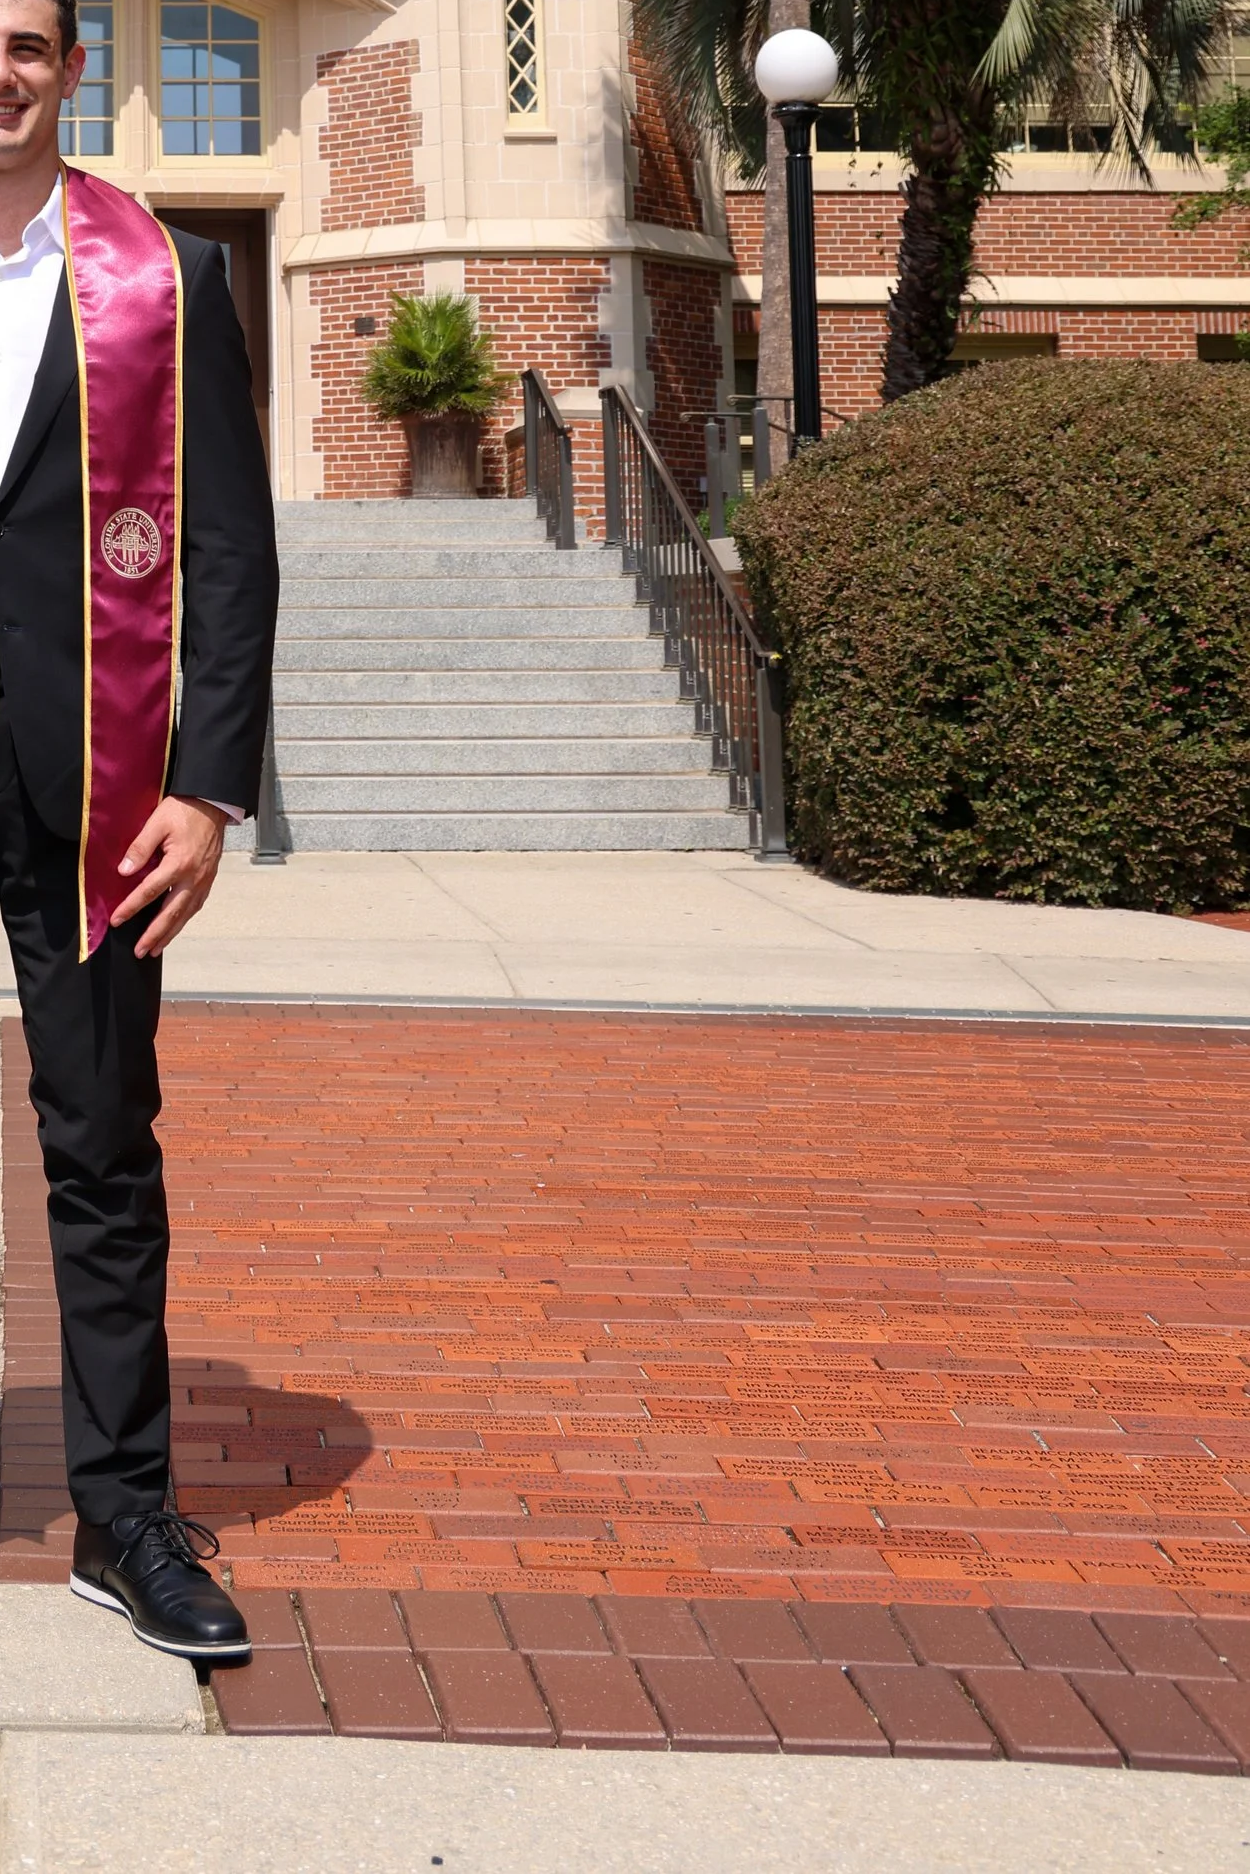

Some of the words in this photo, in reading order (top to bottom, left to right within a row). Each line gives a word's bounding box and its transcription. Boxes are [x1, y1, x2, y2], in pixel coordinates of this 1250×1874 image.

[105, 523, 116, 559] FLORIDA
[115, 512, 137, 523] STATE
[138, 515, 158, 563] UNIVERSITY
[123, 566, 139, 574] 1851
[765, 1383, 831, 1391] Memory
[813, 1479, 895, 1488] Matthew
[1070, 1478, 1174, 1486] Engineering
[979, 1486, 1051, 1495] Andrew
[823, 1492, 876, 1500] Class
[999, 1499, 1051, 1507] Class
[1057, 1501, 1074, 1509] of
[1080, 1503, 1129, 1511] 2023
[295, 1512, 319, 1520] Jay
[323, 1512, 415, 1520] Willoughby
[267, 1519, 333, 1527] Founder
[354, 1520, 418, 1528] Director
[269, 1526, 352, 1534] Classroom
[357, 1527, 420, 1536] Support
[815, 1526, 872, 1534] Taylor
[591, 1544, 669, 1552] Eldridge
[914, 1542, 972, 1550] Noles!
[897, 1552, 971, 1562] JOSHUA
[976, 1556, 1057, 1566] NUGENT
[261, 1562, 330, 1570] Amber
[296, 1569, 356, 1577] Jones
[668, 1575, 734, 1583] Angela
[665, 1581, 743, 1589] Gaskins
